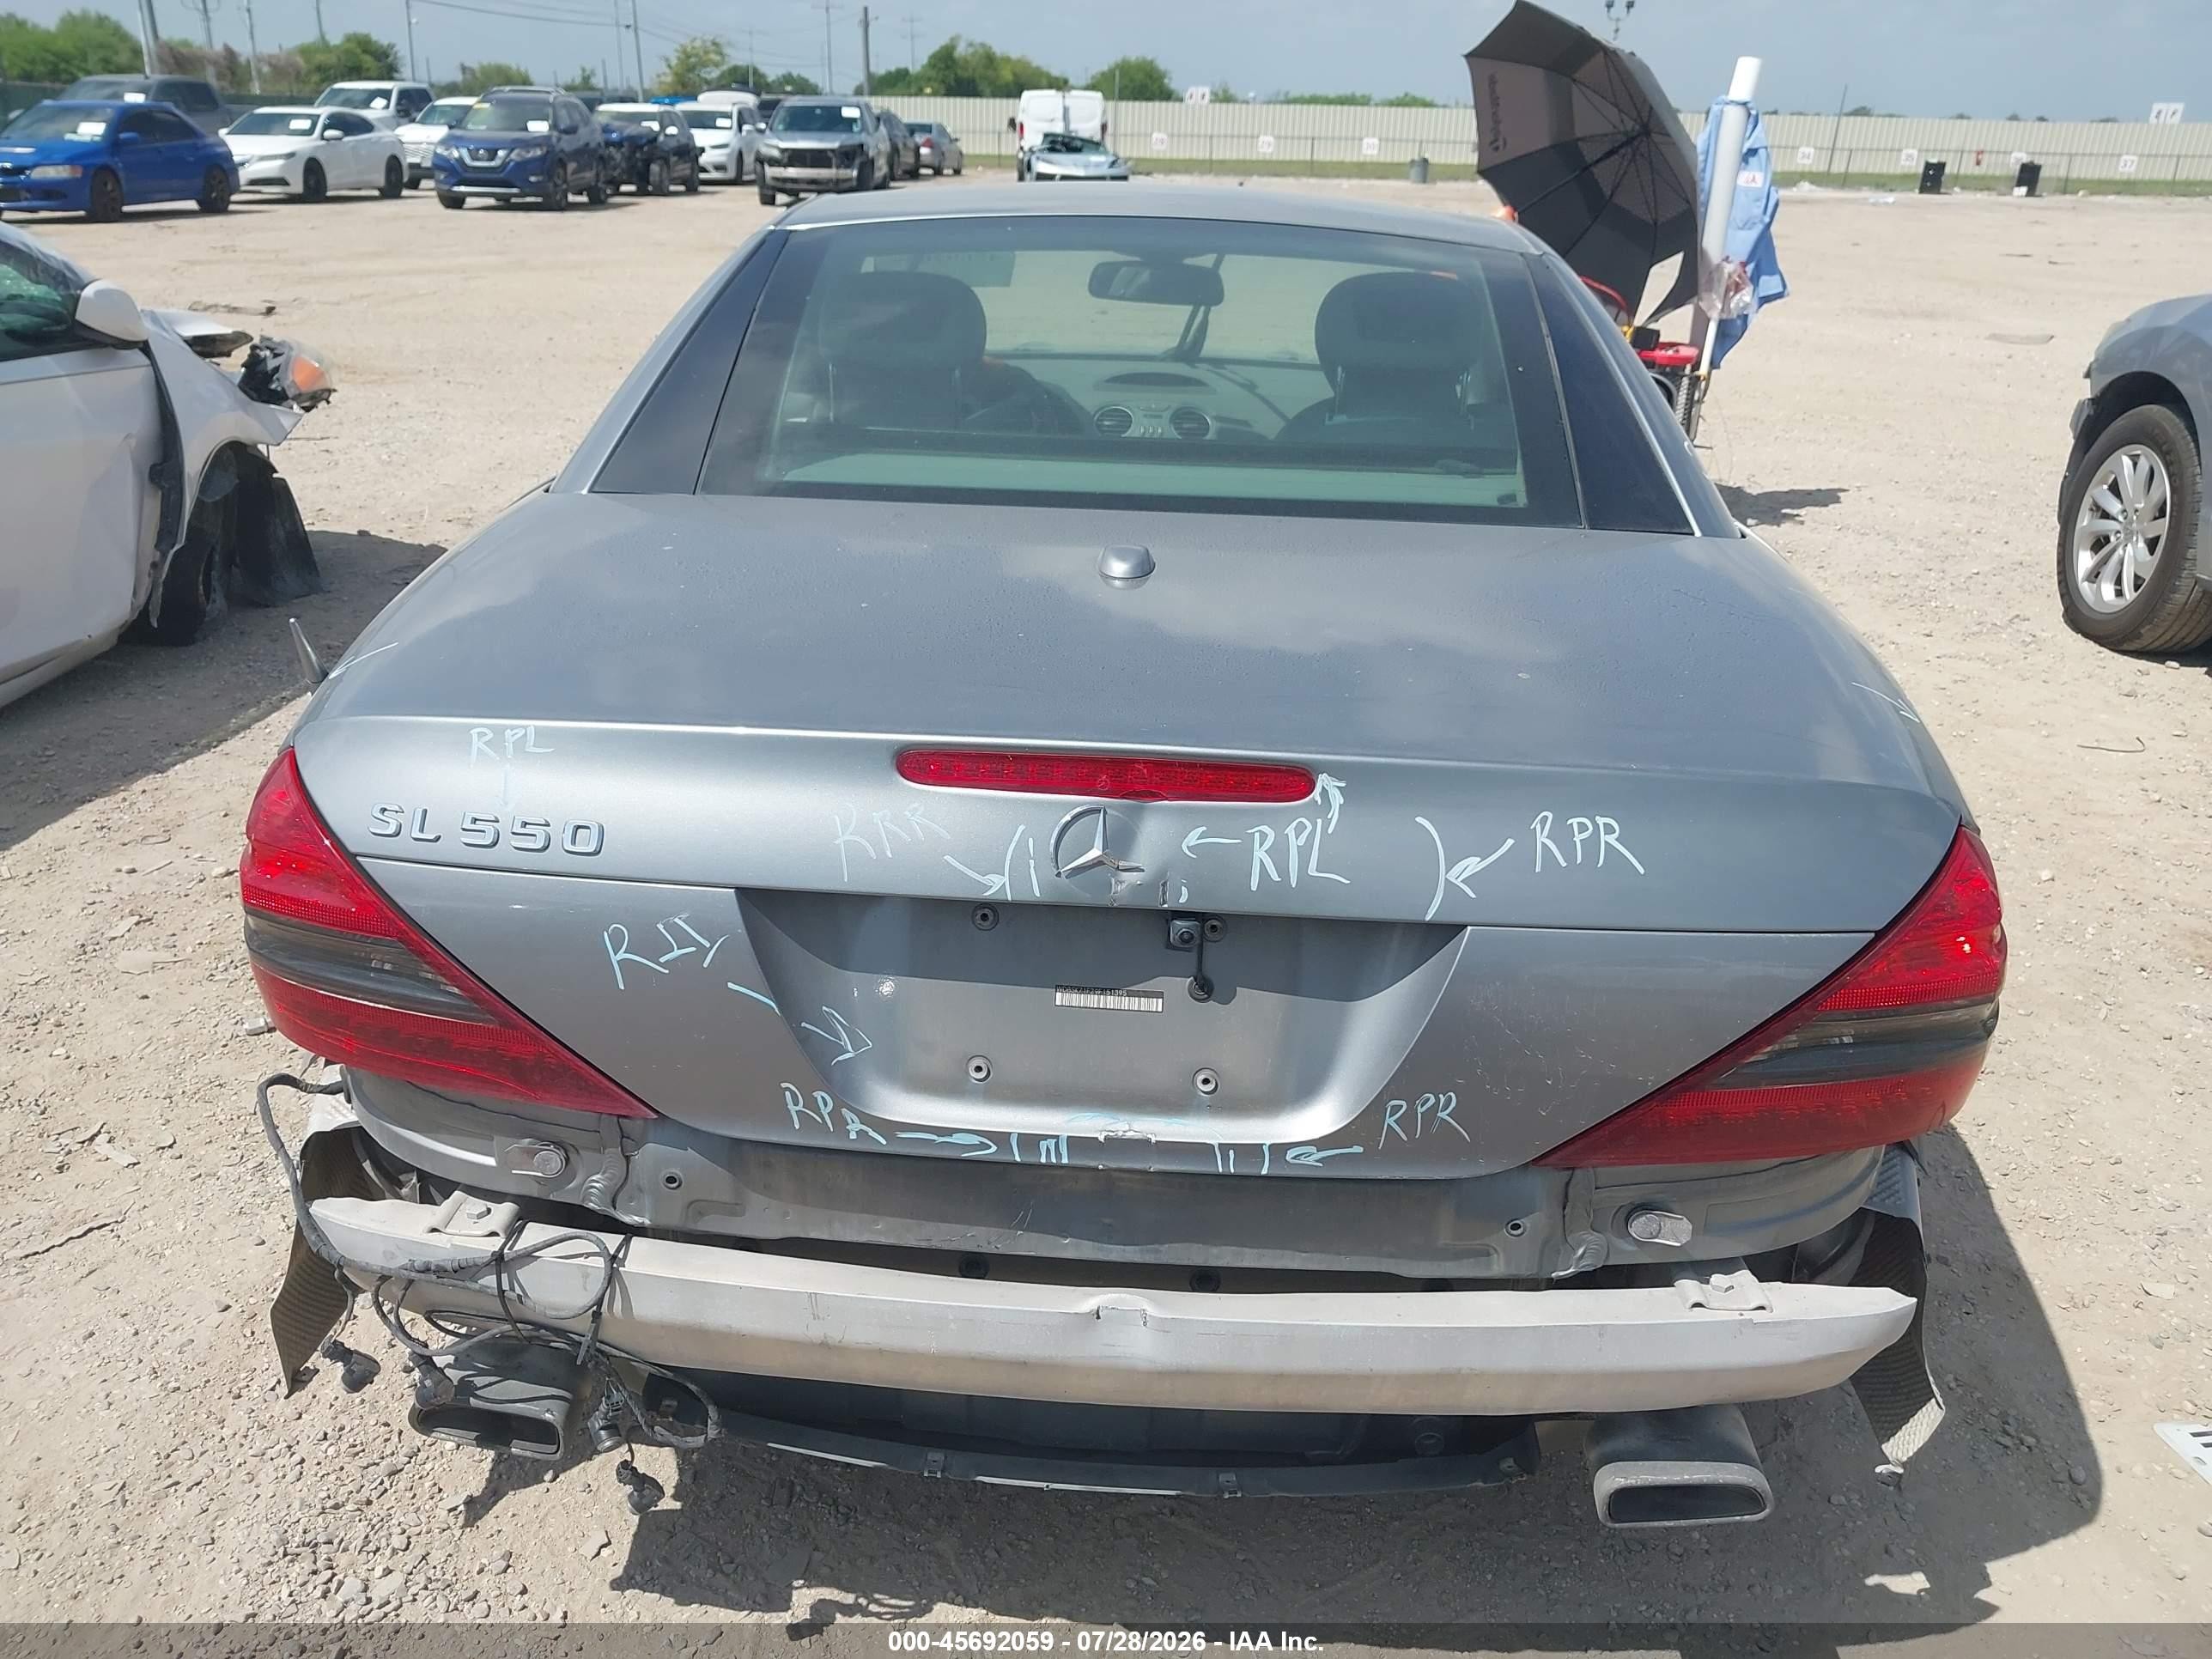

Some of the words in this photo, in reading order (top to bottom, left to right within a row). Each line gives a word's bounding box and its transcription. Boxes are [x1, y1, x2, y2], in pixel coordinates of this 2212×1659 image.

[469, 724, 554, 768] RPL
[368, 803, 442, 843] SL
[459, 811, 605, 857] 550
[1245, 817, 1351, 891] RPL
[1529, 811, 1645, 876] RPR
[1378, 1091, 1472, 1150] RPR
